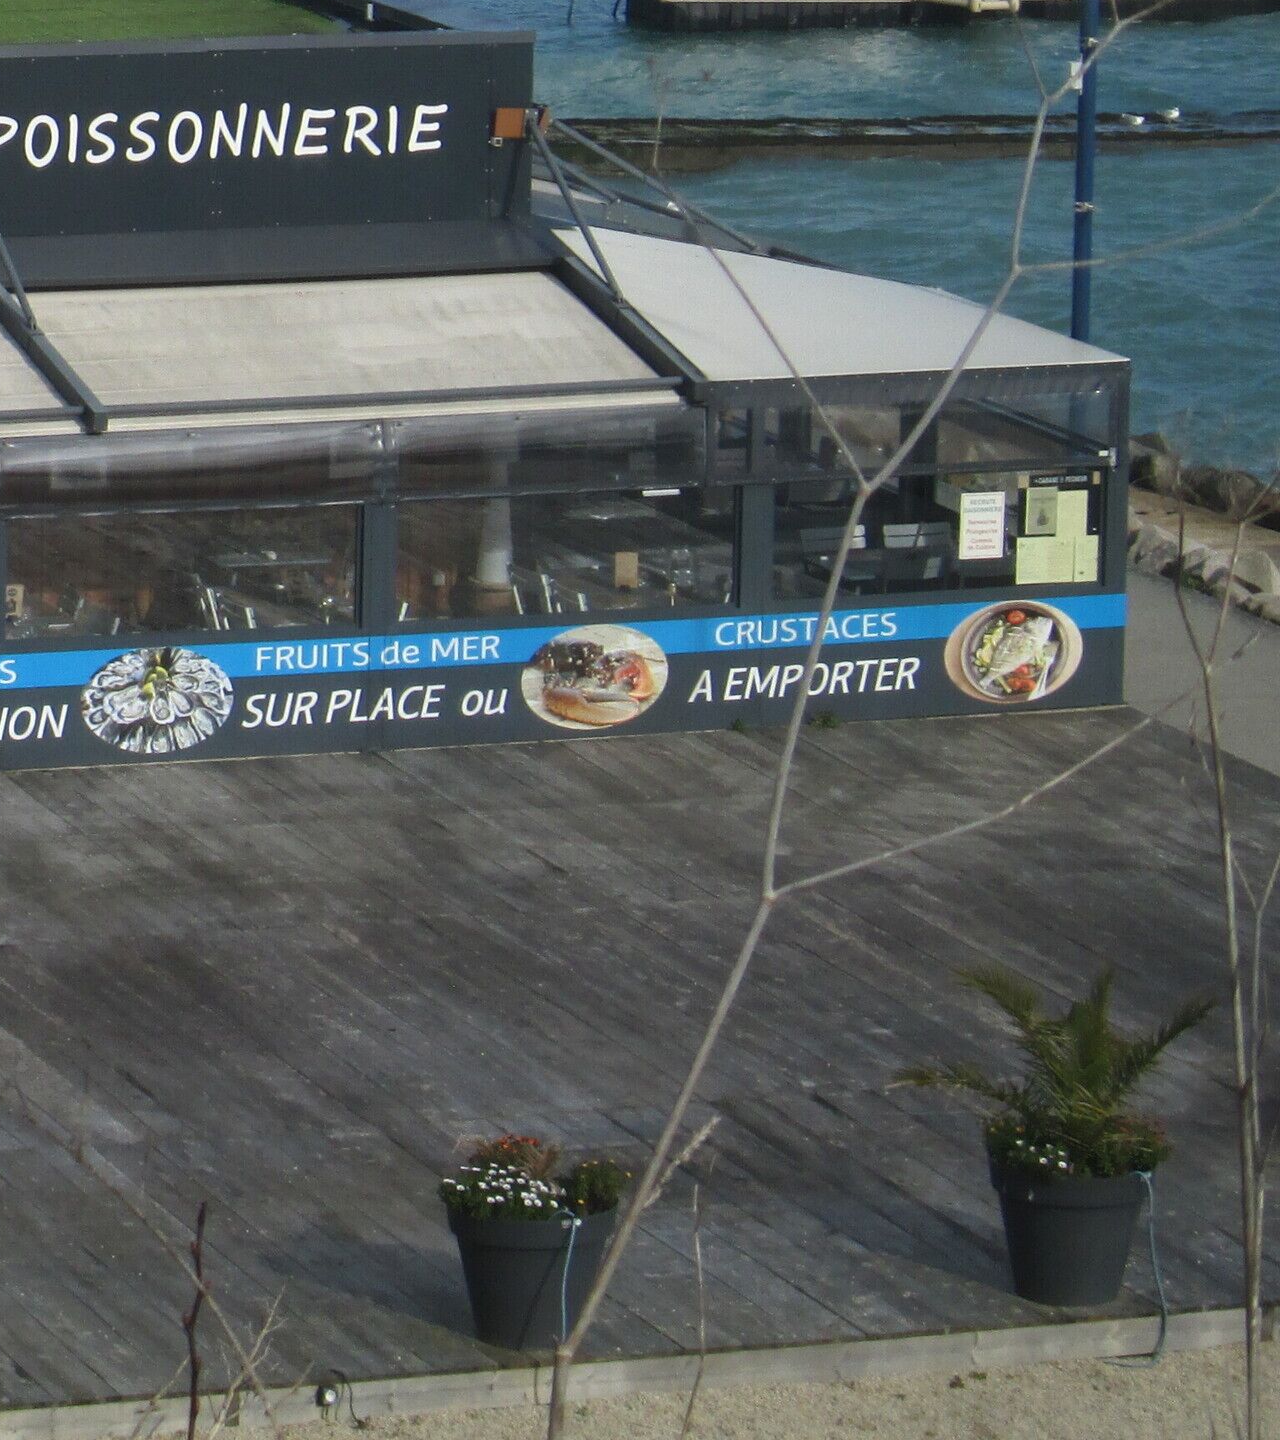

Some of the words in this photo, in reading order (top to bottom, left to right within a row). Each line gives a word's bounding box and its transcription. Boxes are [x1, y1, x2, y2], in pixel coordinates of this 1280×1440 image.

[714, 611, 897, 647] CRUSTACES
[255, 643, 370, 673] FRUITS
[381, 639, 420, 664] de
[431, 635, 501, 662] MER
[688, 679, 714, 703] A
[722, 657, 920, 701] EMPORTER
[241, 691, 317, 729] SUR
[324, 684, 444, 724] PLACE
[462, 690, 507, 715] ou
